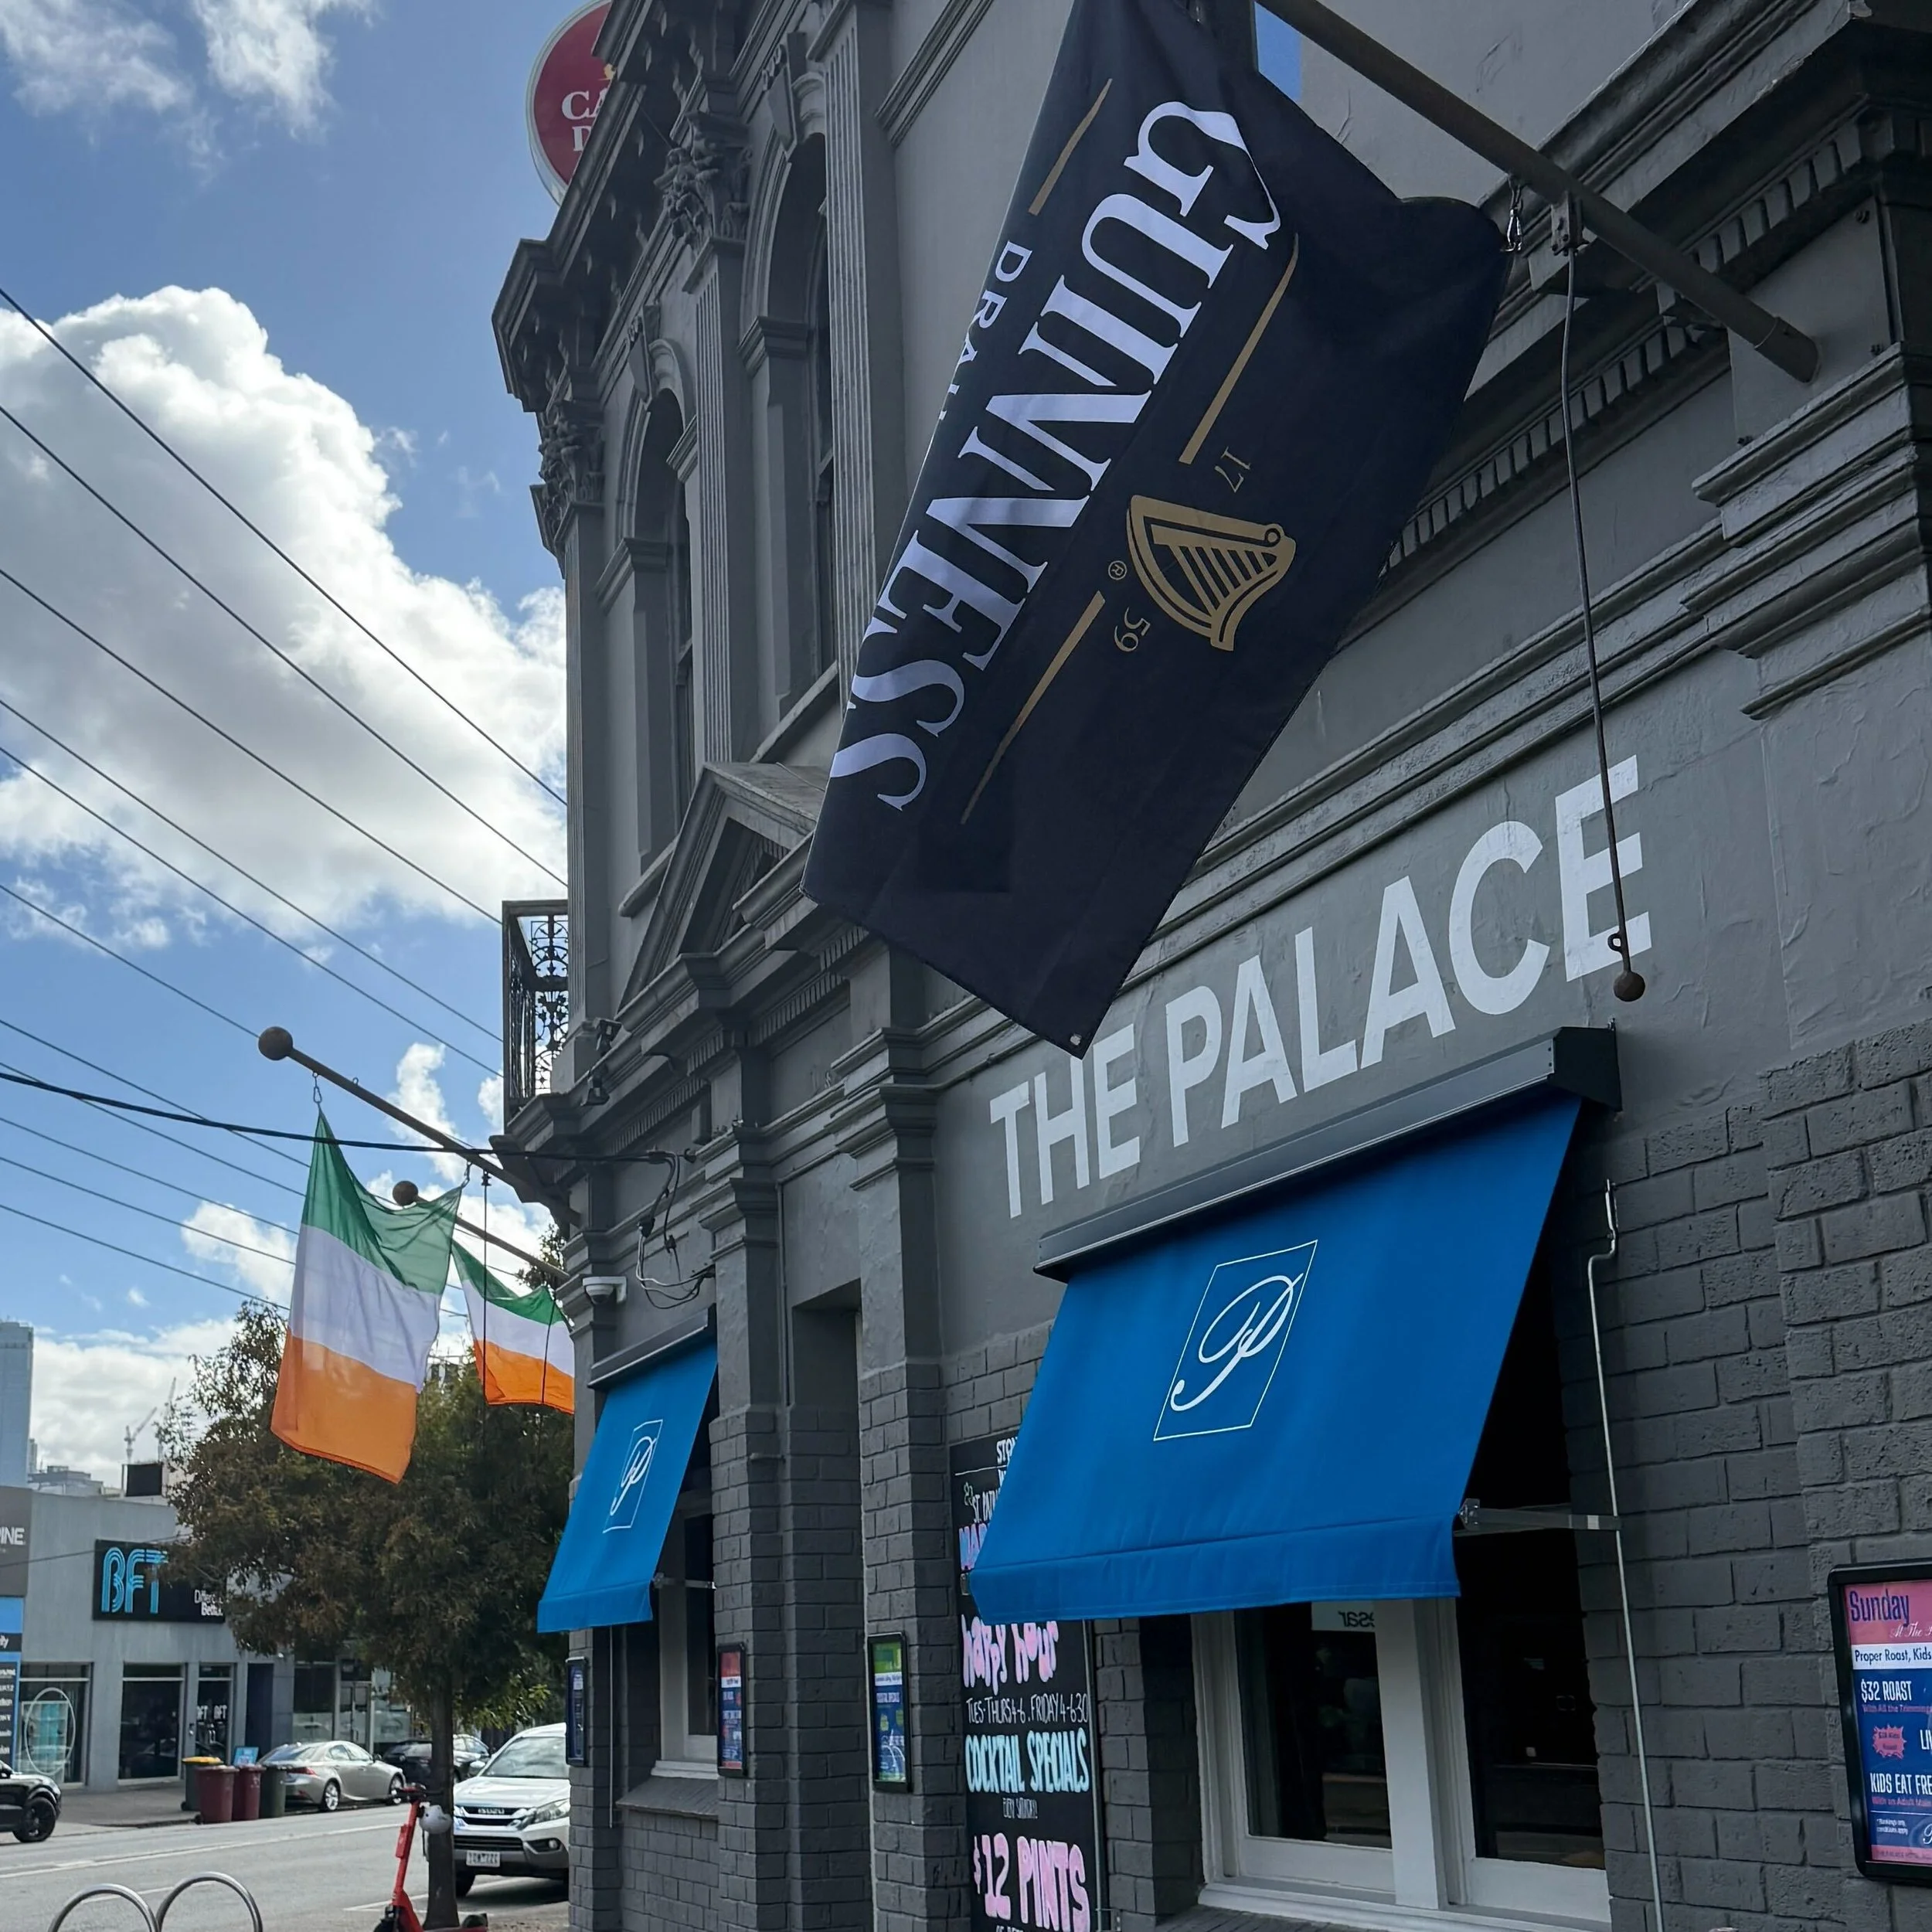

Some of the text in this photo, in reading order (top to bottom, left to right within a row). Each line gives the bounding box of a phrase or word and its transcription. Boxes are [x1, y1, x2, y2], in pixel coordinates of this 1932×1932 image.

[830, 101, 1281, 811] GUINNESS
[1114, 606, 1151, 652] 59
[990, 754, 1653, 1219] THE PALACE
[101, 1547, 168, 1613] BFT
[1849, 1588, 1910, 1628] Sunday
[1904, 1621, 1923, 1638] The
[1855, 1646, 1932, 1665] Proper Roast, Kids
[1861, 1679, 1912, 1703] $32 ROAST
[965, 1727, 1090, 1794] COCKTAIL SPECIALS
[1870, 1773, 1893, 1794] KIDS
[1895, 1774, 1912, 1794] EAT
[974, 1832, 1091, 1932] $12 PINTS
